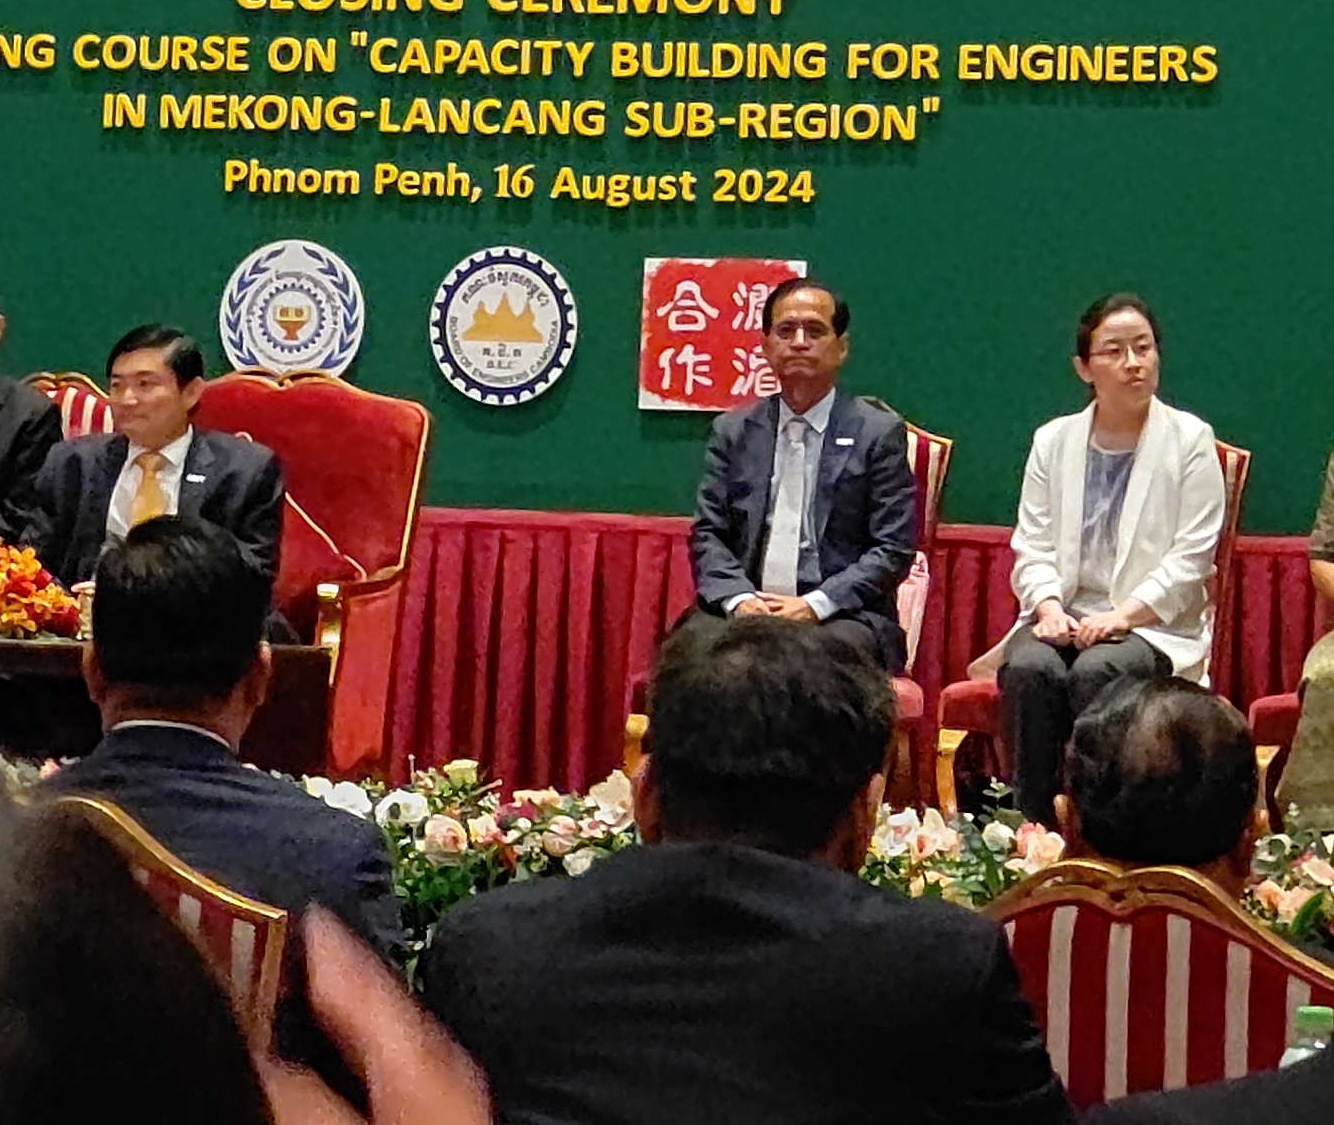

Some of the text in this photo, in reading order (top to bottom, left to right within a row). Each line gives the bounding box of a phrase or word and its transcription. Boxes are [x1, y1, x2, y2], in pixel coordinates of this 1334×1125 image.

[72, 33, 250, 72] COURSE
[267, 36, 337, 73] ON
[350, 30, 595, 77] "CAPACITY
[611, 41, 827, 79] BUILDING
[847, 42, 940, 80] FOR
[958, 43, 1218, 83] ENGINEERS
[102, 92, 940, 141] IN MEKONG-LANCANG SUB-REGION"
[224, 158, 816, 208] Phnom Penh, 16 August 2024
